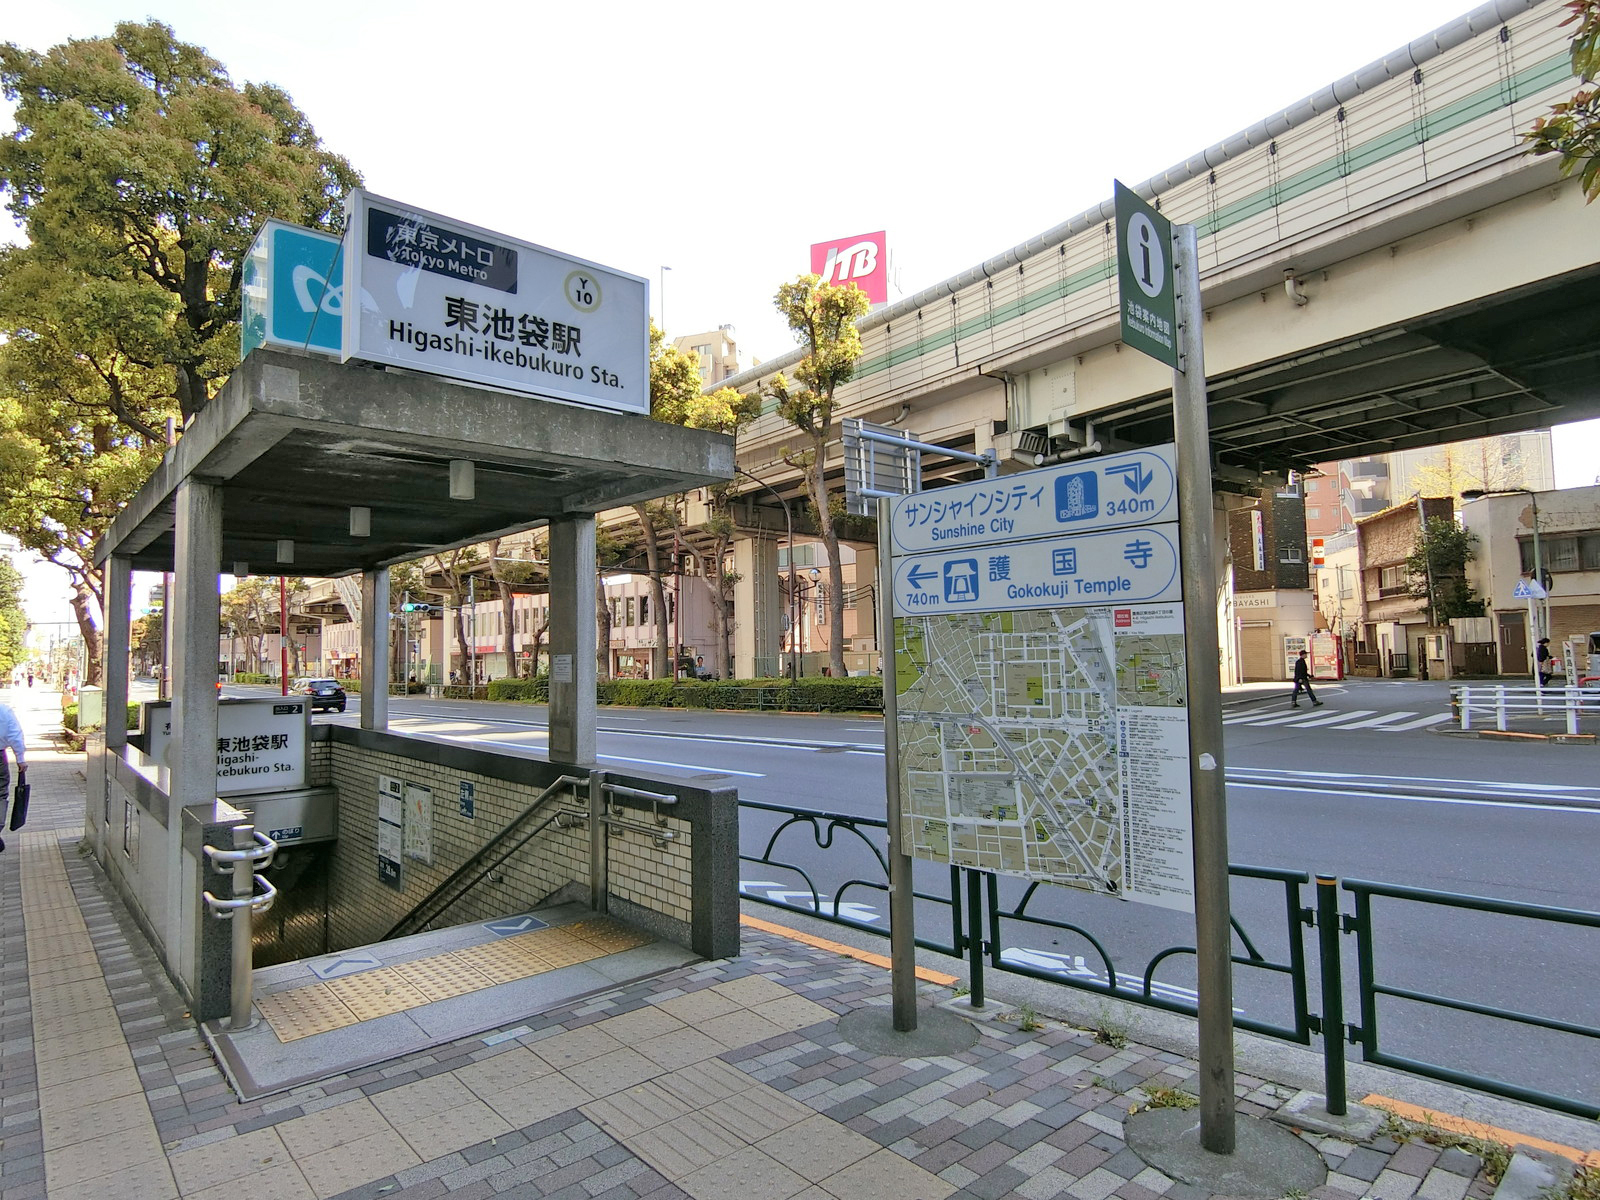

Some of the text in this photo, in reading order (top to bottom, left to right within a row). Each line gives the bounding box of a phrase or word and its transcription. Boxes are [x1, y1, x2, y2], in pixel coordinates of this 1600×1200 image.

[398, 225, 495, 267] 東京メトロ
[402, 246, 489, 282] Tokyo Metro
[814, 241, 879, 289] JTB
[578, 277, 589, 289] Y
[576, 288, 594, 307] 10
[444, 295, 582, 358] 東池袋駅
[1127, 299, 1170, 336] 池袋案内地図
[388, 319, 625, 391] Higashi-ikebukuro Sta.
[904, 484, 1045, 528] サンシャインシティ
[1106, 497, 1155, 517] 340m
[931, 517, 1015, 542] Sunshine City
[906, 592, 940, 607] 740m
[1007, 576, 1132, 600] Gokokuji Temple
[292, 705, 298, 713] 2
[217, 733, 289, 753] 東池袋駅
[273, 763, 295, 773] Sta.
